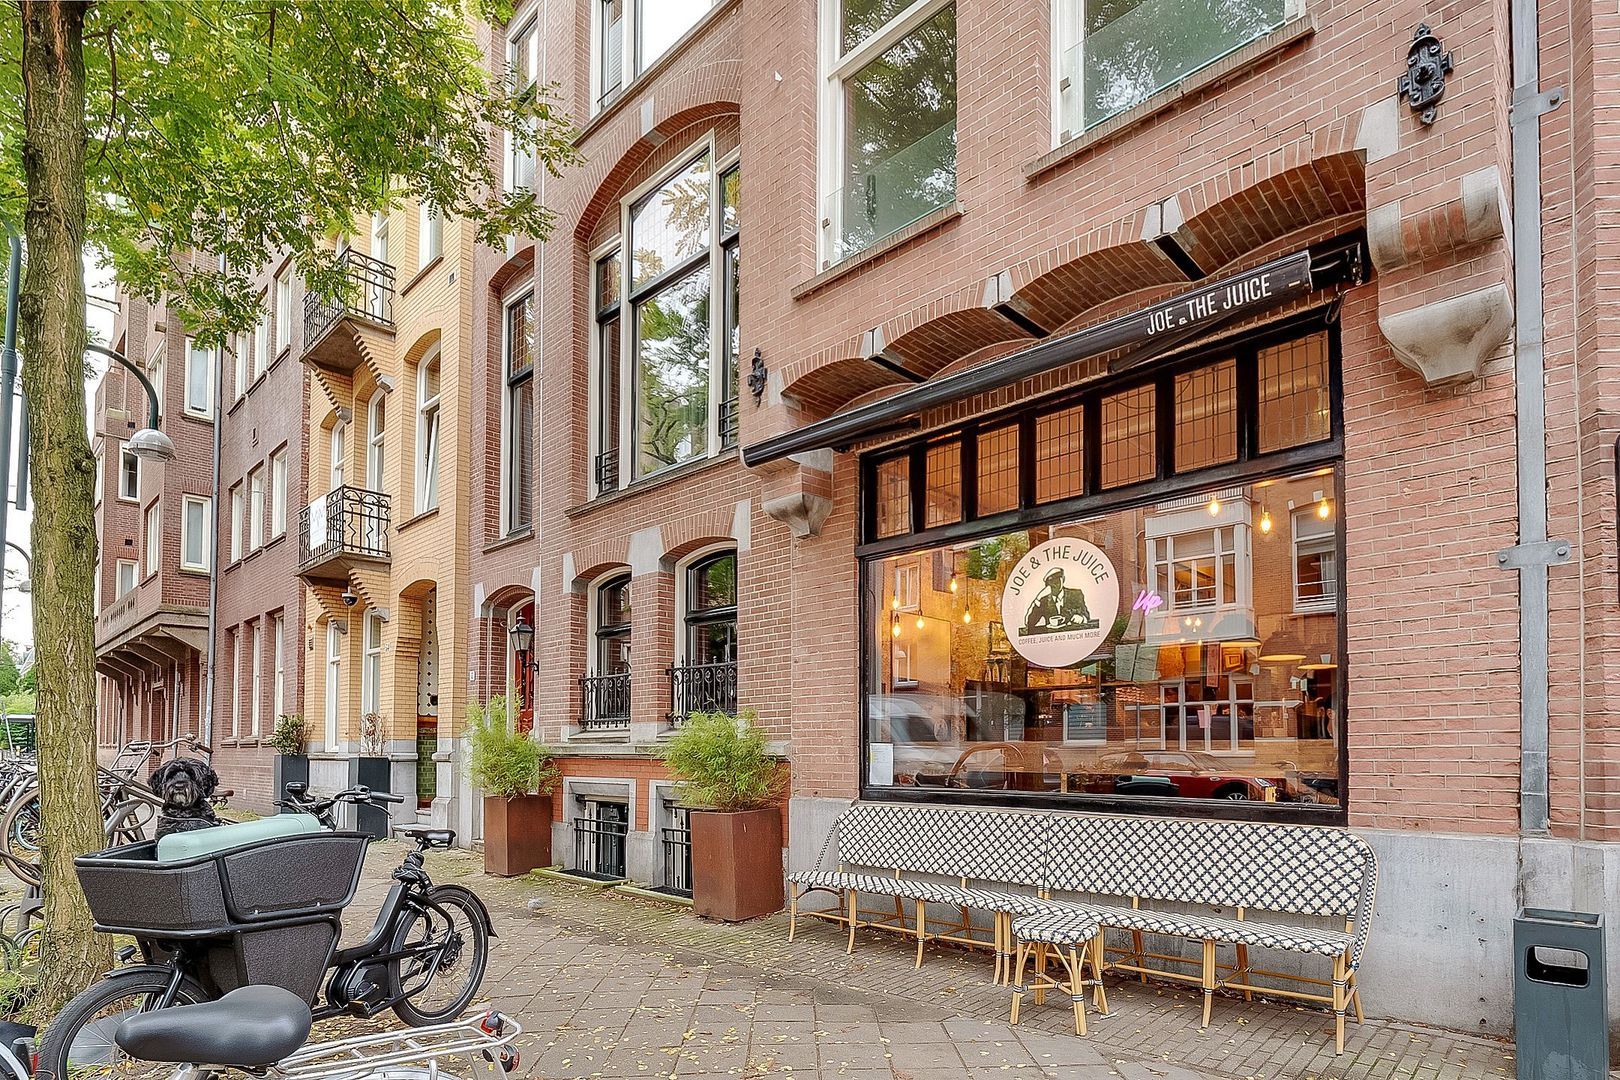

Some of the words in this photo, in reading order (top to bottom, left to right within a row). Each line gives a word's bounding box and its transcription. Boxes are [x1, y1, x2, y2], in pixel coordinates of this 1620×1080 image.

[1146, 307, 1175, 336] JOE
[1178, 317, 1188, 326] &
[1186, 292, 1218, 321] THE
[1223, 273, 1272, 310] JUICE
[1009, 566, 1031, 596] JOE
[1030, 556, 1041, 570] &
[1043, 545, 1072, 562] THE
[1073, 549, 1110, 585] JUICE
[1038, 636, 1054, 644] JUICE
[1054, 634, 1066, 642] AND
[1066, 632, 1084, 641] MUCH
[1084, 630, 1101, 639] MORE
